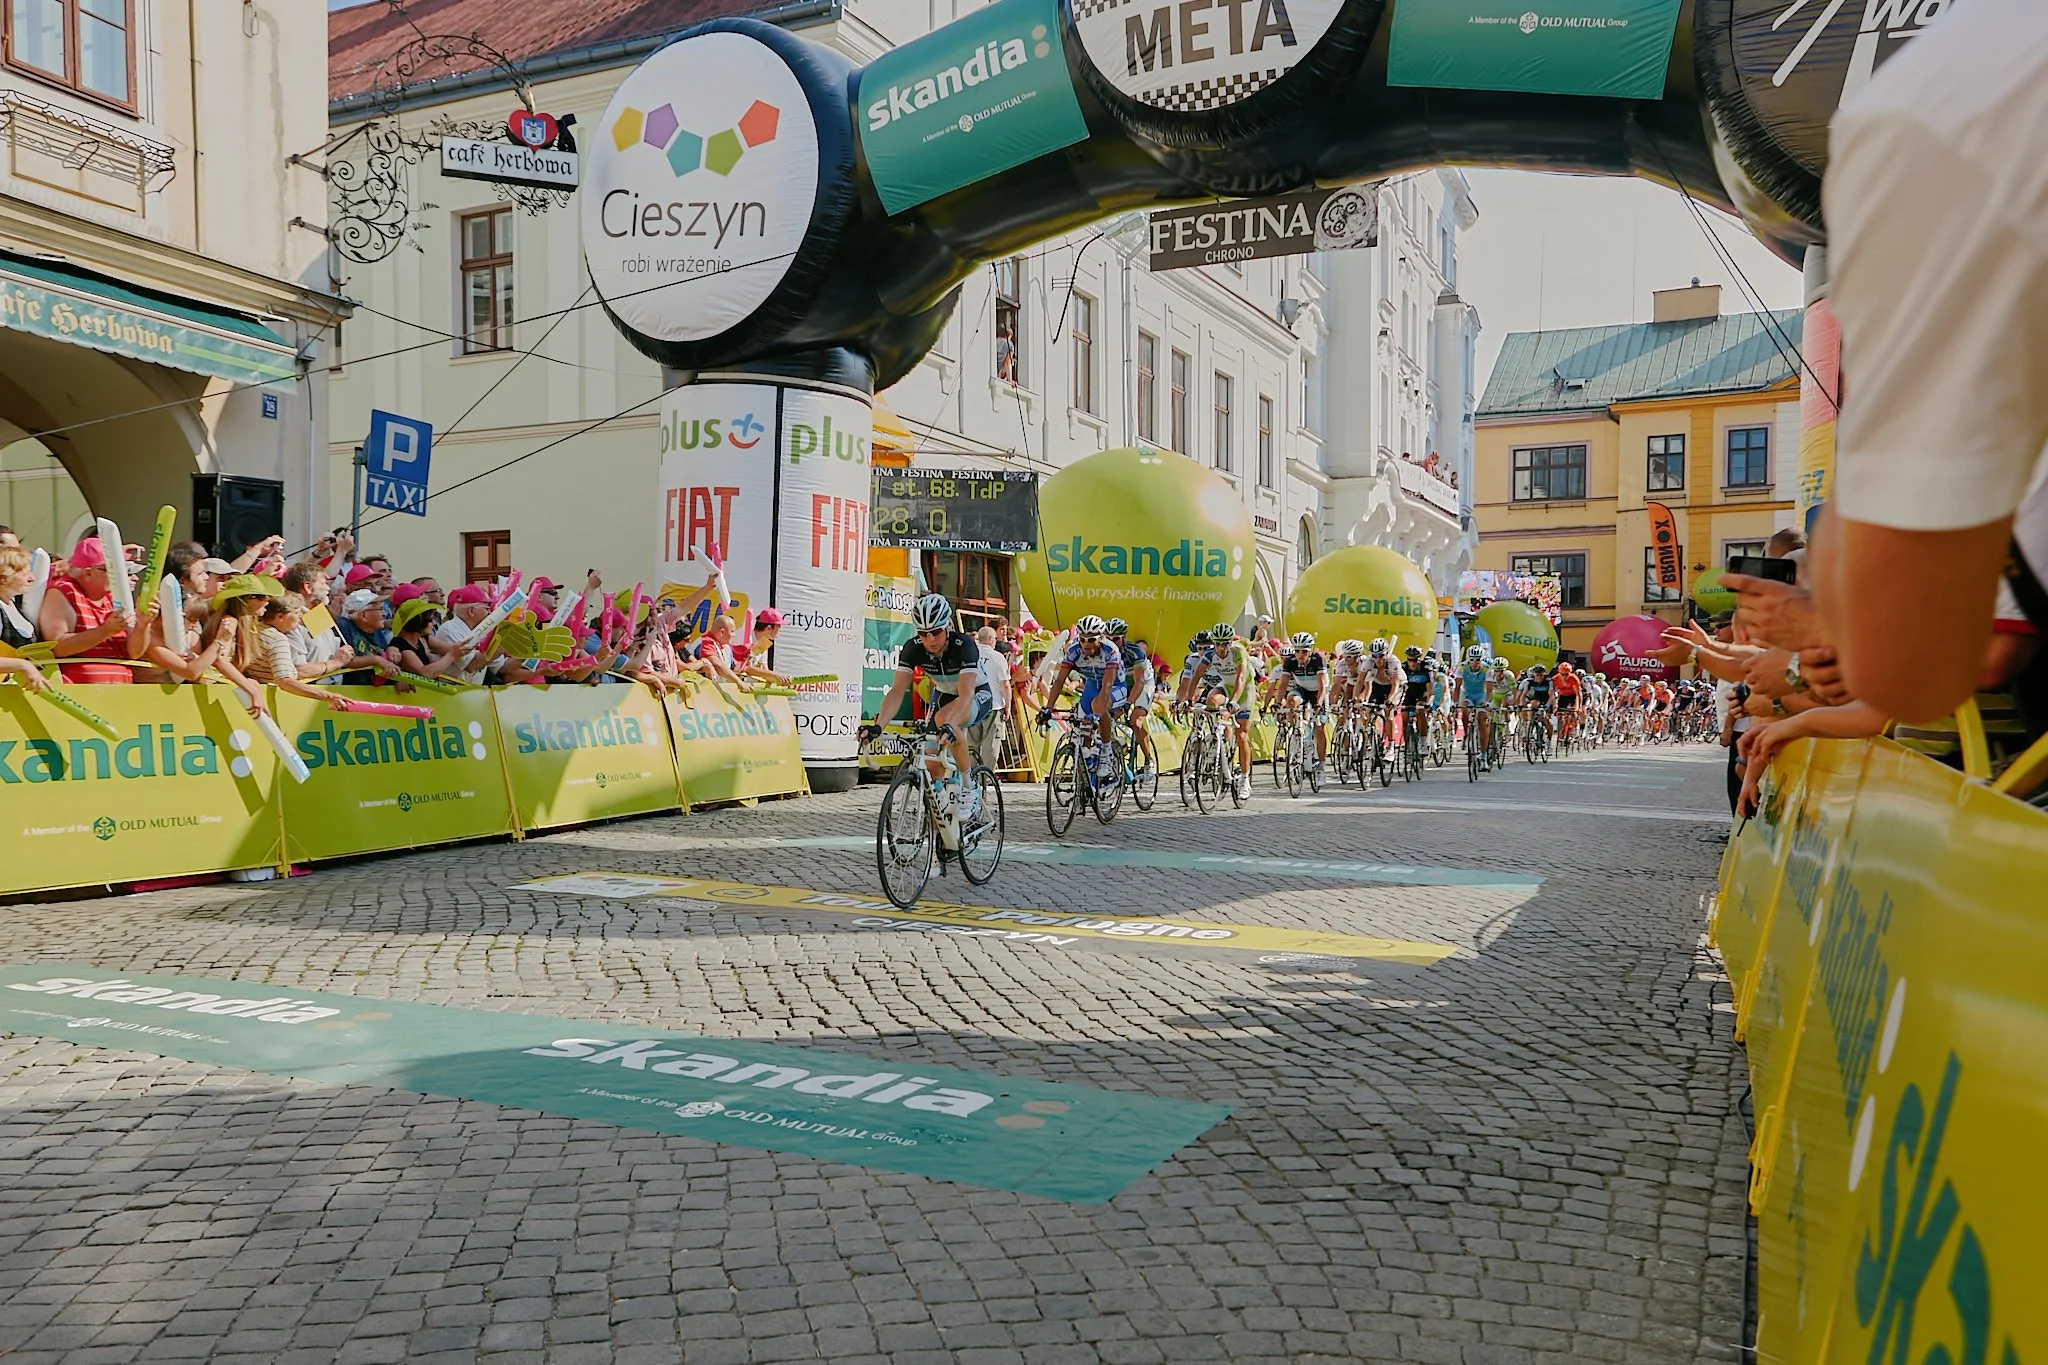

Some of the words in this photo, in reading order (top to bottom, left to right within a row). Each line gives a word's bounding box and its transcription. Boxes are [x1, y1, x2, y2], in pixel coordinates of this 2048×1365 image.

[1125, 0, 1297, 76] META
[1475, 16, 1500, 24] Member
[1508, 16, 1518, 24] the
[1541, 16, 1562, 27] OLD
[1563, 18, 1607, 28] MUTUAL
[1607, 18, 1628, 27] Group
[867, 38, 1028, 132] skandia
[974, 109, 991, 122] OLD
[991, 96, 1022, 116] MUTUAL
[449, 144, 484, 166] café
[494, 147, 573, 175] herbowa
[601, 189, 766, 249] Cieszyn
[1150, 202, 1315, 255] FESTINA
[622, 253, 650, 273] robi
[656, 255, 731, 273] wrażenie
[1205, 245, 1255, 263] CHRONO
[382, 420, 419, 472] P
[661, 410, 722, 465] plus
[790, 415, 865, 465] plus
[901, 468, 944, 479] FESTINA
[952, 470, 994, 480] FESTINA
[968, 480, 1005, 500] TdP
[369, 477, 425, 513] TAXI
[665, 487, 740, 562] FIAT
[811, 493, 868, 574] FIAT
[899, 538, 941, 549] FESTINA
[949, 540, 991, 550] FESTINA
[1049, 536, 1227, 578] skandia
[1086, 585, 1158, 602] przyszłość
[1163, 586, 1223, 601] finansowa
[1324, 593, 1423, 617] skandia
[1502, 631, 1557, 652] skandia
[788, 693, 840, 703] ACHODNI
[792, 682, 840, 694] ZIENNIK
[515, 709, 643, 754] skandia
[679, 704, 779, 741] skandia
[298, 716, 466, 769] skandia
[414, 794, 430, 804] OLD
[430, 791, 461, 802] MUTUAL
[120, 820, 146, 831] OLD
[149, 816, 200, 828] MUTUAL
[5, 978, 341, 1024] skandia
[521, 1038, 994, 1119] skandia
[723, 1109, 774, 1124] OLD
[772, 1119, 867, 1140] MUTUAL
